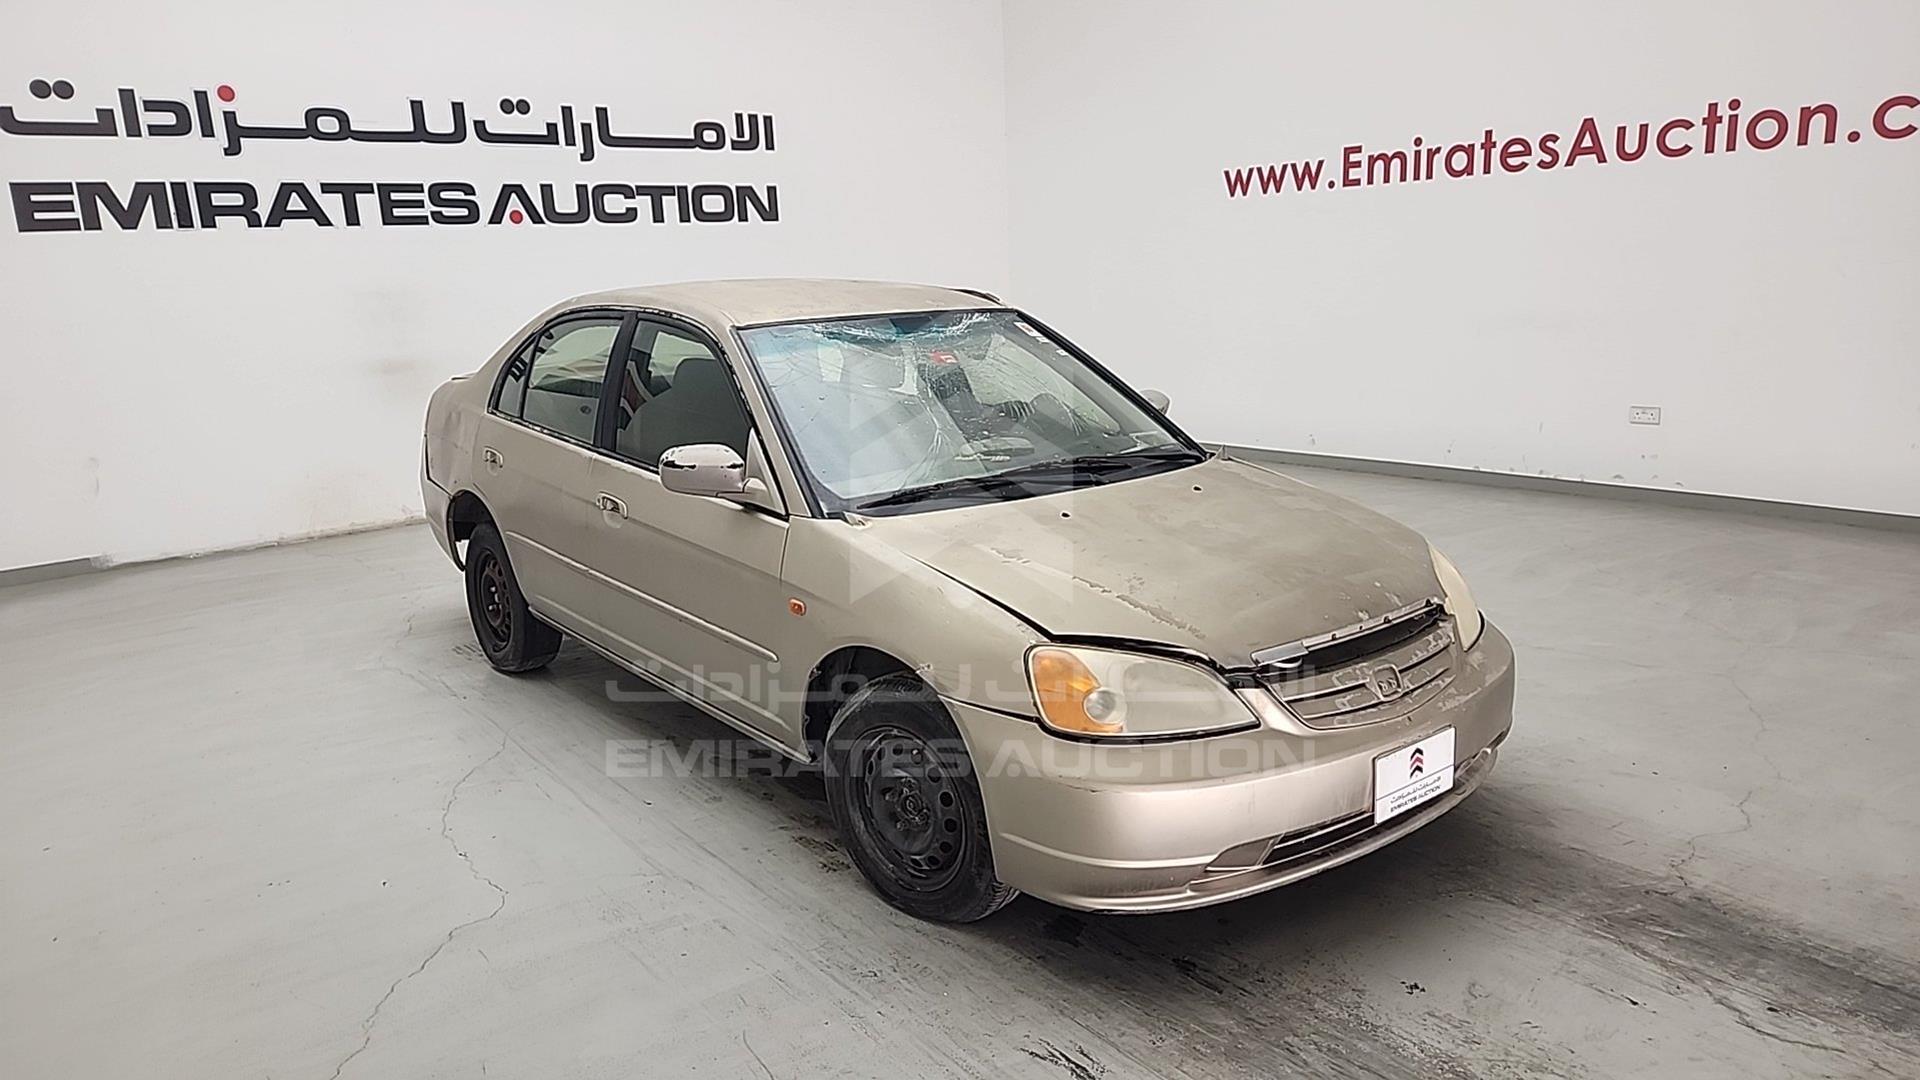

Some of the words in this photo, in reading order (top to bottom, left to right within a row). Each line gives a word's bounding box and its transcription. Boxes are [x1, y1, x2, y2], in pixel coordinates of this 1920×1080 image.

[1224, 95, 1920, 197] www.EmiratesAuction.c
[8, 181, 482, 233] EMIRATES
[487, 183, 780, 225] AUCTION
